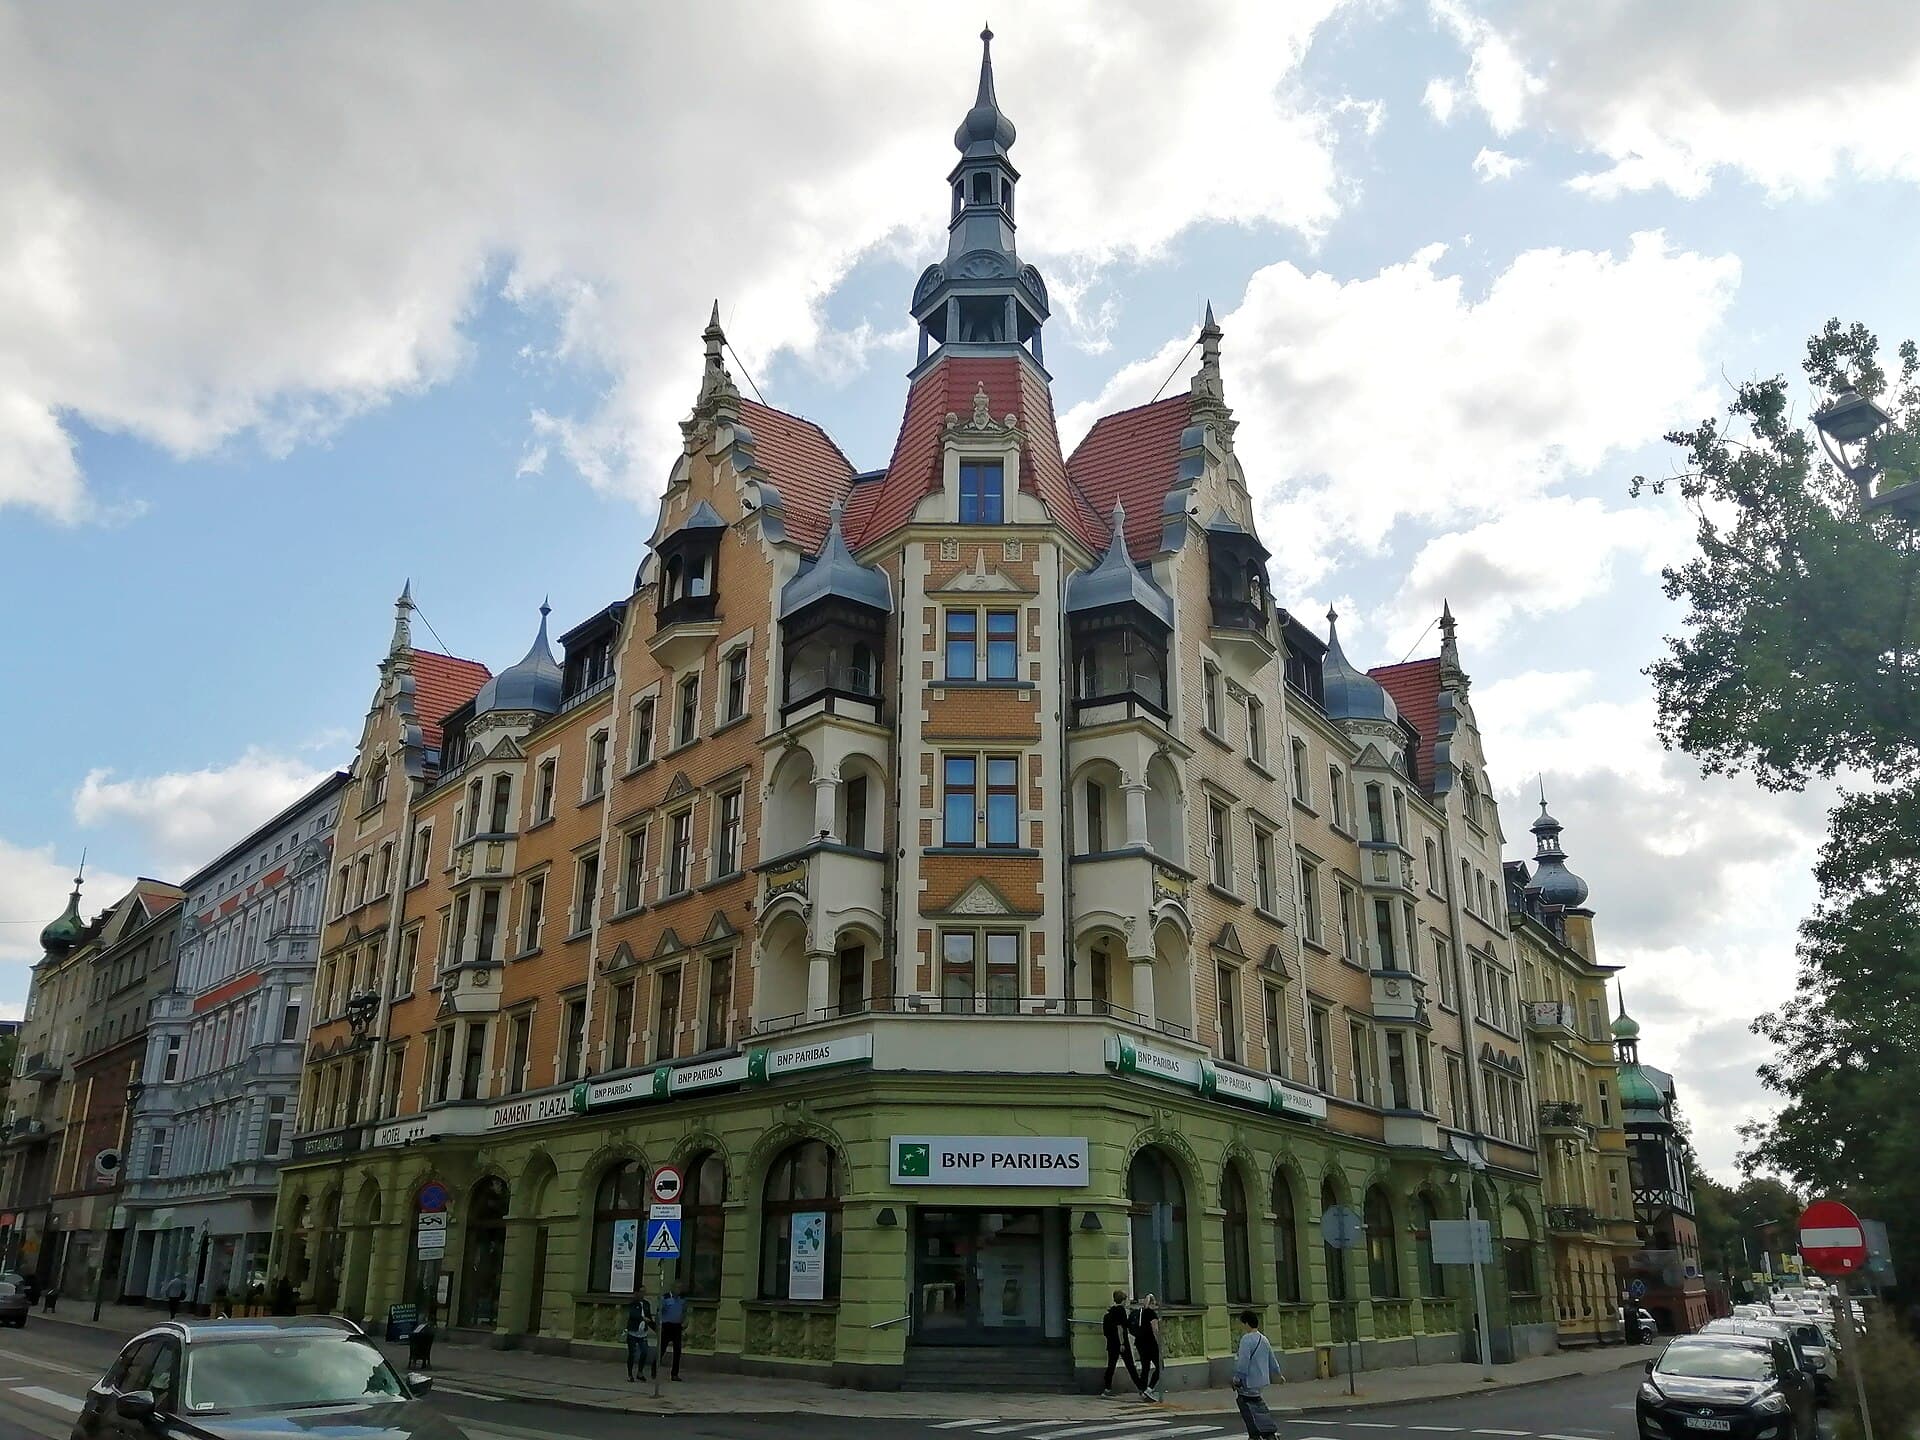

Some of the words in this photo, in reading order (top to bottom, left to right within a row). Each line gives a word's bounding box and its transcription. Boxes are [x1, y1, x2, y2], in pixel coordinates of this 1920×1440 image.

[777, 1053, 794, 1067] BNP
[795, 1046, 830, 1064] PARIBAS
[1137, 1051, 1152, 1064] BNP
[1152, 1055, 1180, 1073] PARIBAS
[677, 1072, 692, 1085] BNP
[693, 1066, 723, 1082] PARIBAS
[1216, 1073, 1228, 1085] BNP
[1228, 1076, 1252, 1093] PARIBAS
[594, 1086, 607, 1099] BNP
[607, 1082, 633, 1097] PARIBAS
[1292, 1094, 1313, 1109] PARIBAS
[493, 1103, 531, 1126] DIAMENT
[538, 1097, 567, 1119] PLAZA
[381, 1128, 400, 1145] HOTEL
[941, 1152, 985, 1168] BNP
[991, 1153, 1080, 1169] PARIBAS
